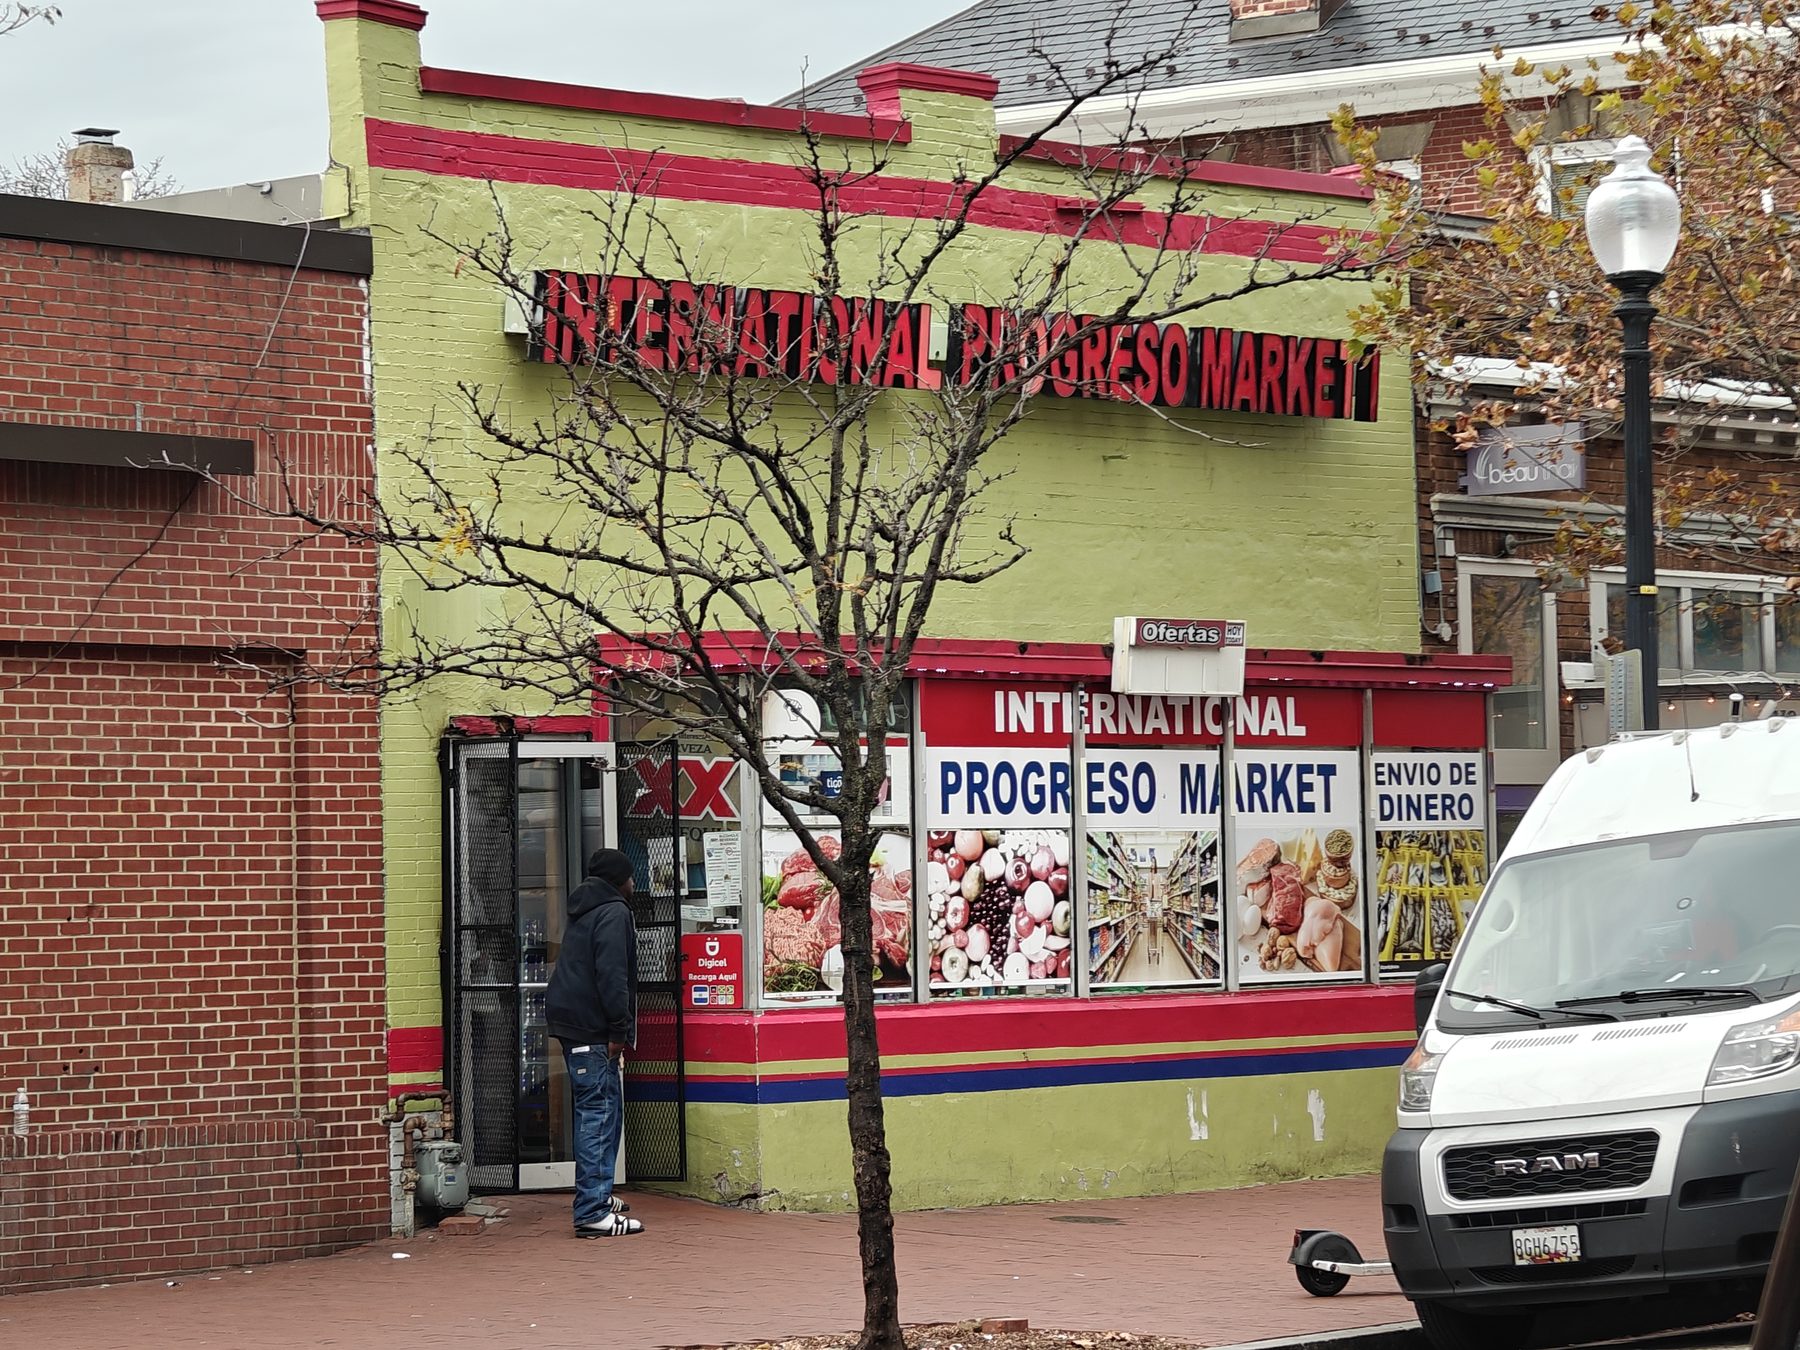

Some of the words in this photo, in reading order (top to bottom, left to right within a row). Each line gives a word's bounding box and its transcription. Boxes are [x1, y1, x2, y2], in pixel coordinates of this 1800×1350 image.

[543, 268, 942, 391] INTERNATIONAL
[960, 302, 1189, 408] PROGRESO
[1200, 326, 1367, 420] MARKET
[1489, 462, 1538, 484] beau
[1142, 622, 1220, 642] Ofertas
[1227, 626, 1241, 635] HOY
[994, 690, 1307, 737] INTERNATIONAL
[1374, 762, 1442, 786] ENVIO
[1449, 762, 1477, 786] DE
[941, 761, 1156, 815] PROGRESO
[1180, 763, 1338, 815] MARKET
[1378, 793, 1474, 821] DINERO
[698, 958, 728, 969] Digicel
[1494, 1152, 1600, 1178] RAM
[1515, 1234, 1579, 1258] 8GH6755
